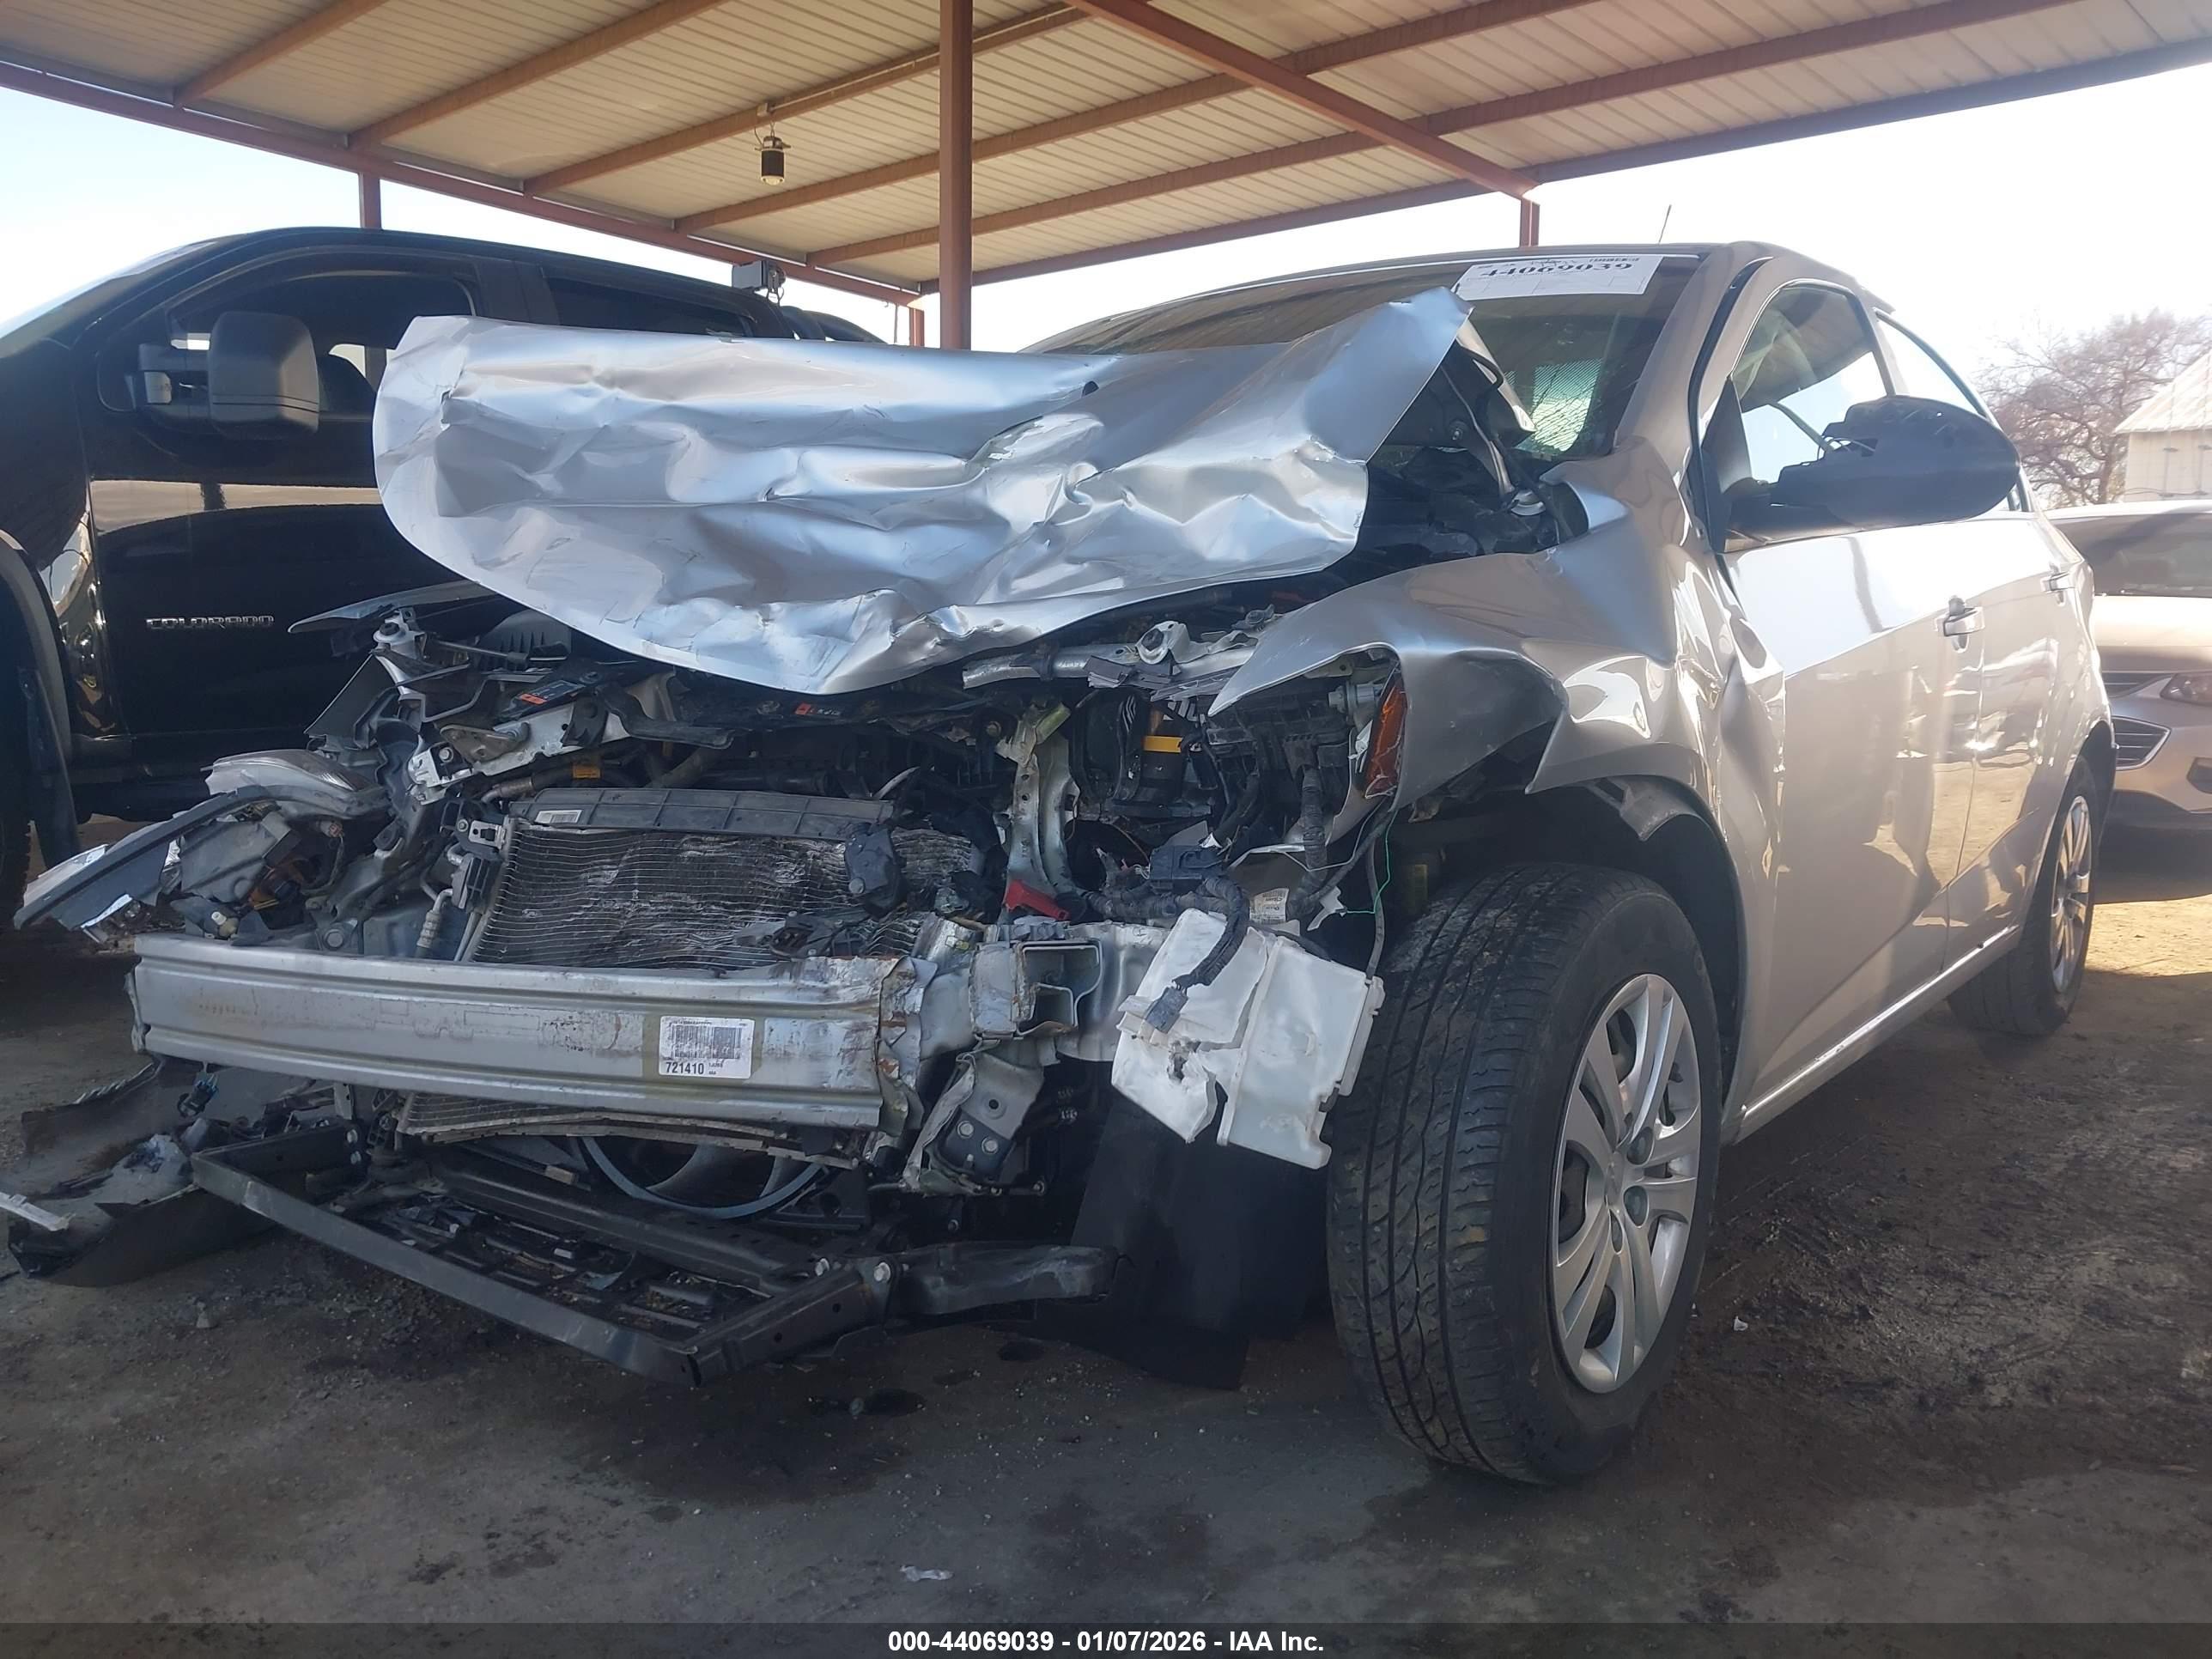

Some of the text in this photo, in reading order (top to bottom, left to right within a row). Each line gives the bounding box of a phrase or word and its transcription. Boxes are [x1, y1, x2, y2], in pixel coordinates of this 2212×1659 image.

[1480, 262, 1632, 277] 44069039
[145, 615, 275, 630] COLORADO
[666, 1061, 704, 1075] 721410
